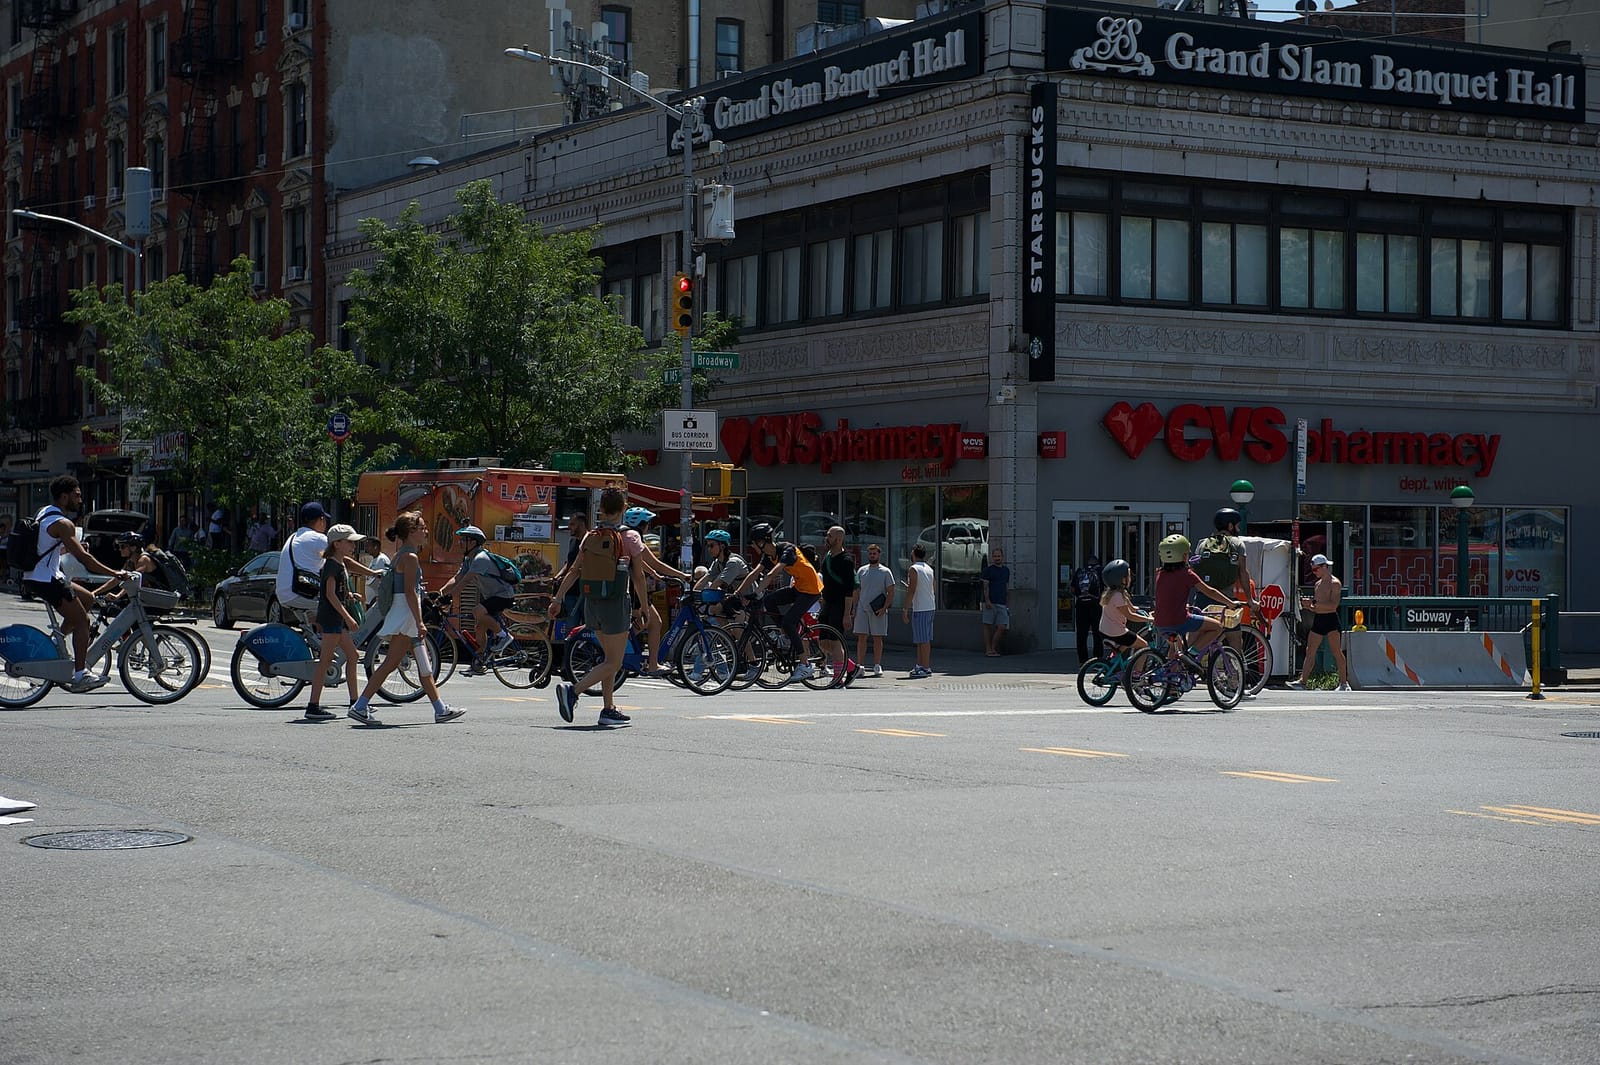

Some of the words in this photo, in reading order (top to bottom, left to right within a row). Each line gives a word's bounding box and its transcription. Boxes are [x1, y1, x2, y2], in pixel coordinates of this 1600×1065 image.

[1164, 31, 1270, 78] Grand
[1278, 44, 1362, 89] Slam
[1372, 54, 1498, 105] Banquet
[1506, 69, 1576, 109] Hall
[714, 85, 770, 130] Grand
[771, 78, 823, 116] Slam
[824, 50, 910, 100] Banquet
[912, 28, 966, 79] Hall
[1030, 105, 1045, 293] STARBUCKS
[697, 354, 733, 368] Broadway
[752, 411, 822, 467] CVS
[820, 418, 961, 474] pharmacy
[969, 438, 984, 446] CVS
[1046, 437, 1057, 445] CVS
[1165, 403, 1288, 464] CVS
[1306, 417, 1501, 478] pharmacy
[500, 483, 529, 501] LA
[1400, 476, 1430, 492] dept.
[1515, 569, 1541, 582] CVS
[1504, 583, 1539, 594] pharmacy
[1260, 595, 1284, 609] STOP
[1407, 609, 1452, 625] Subway
